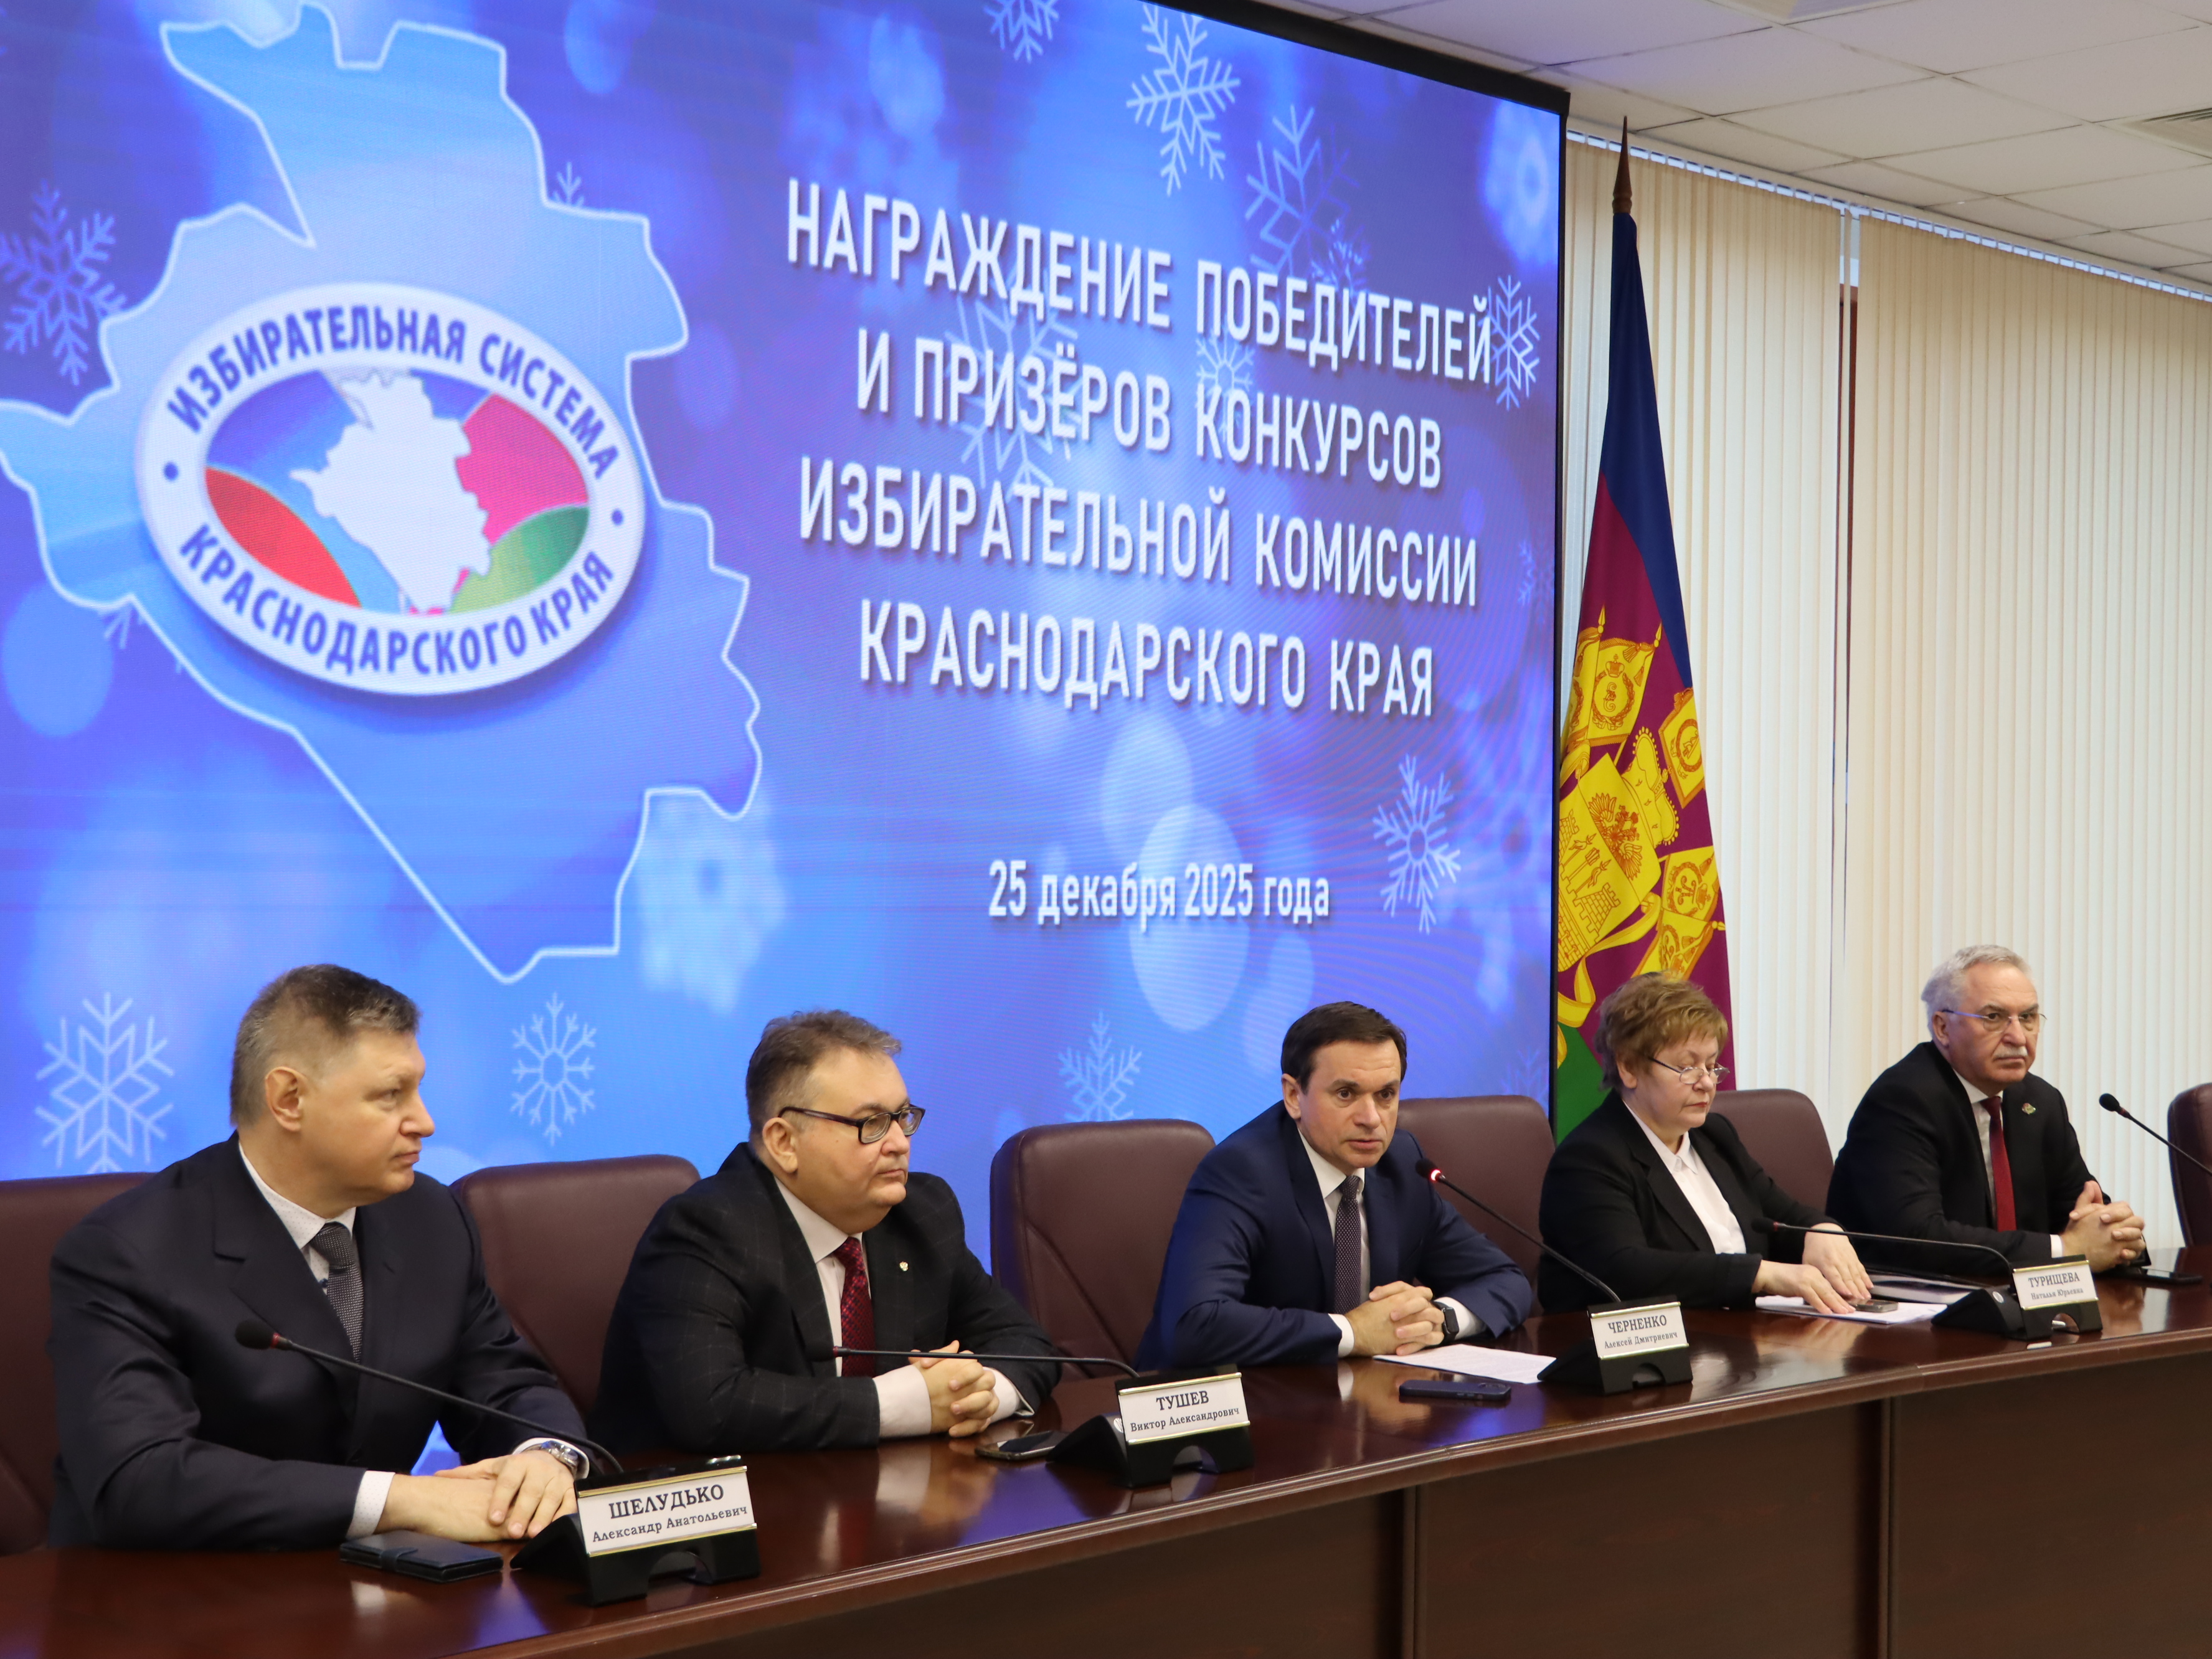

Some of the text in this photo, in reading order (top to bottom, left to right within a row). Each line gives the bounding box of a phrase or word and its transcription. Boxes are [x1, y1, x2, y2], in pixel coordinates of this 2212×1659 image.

[788, 177, 1491, 384] НАГРАЖДЕНИЕ ПОБЕДИТЕЛЕЙ
[168, 305, 619, 479] ИЗБИРАТЕЛЬНАЯ СИСТЕМА
[858, 328, 1441, 488] И ПРИЗЁРОВ КОНКУРСОВ
[800, 456, 1476, 606] ИЗБИРАТЕЛЬНОЙ КОМИССИИ
[181, 524, 613, 674] КРАСНОДАРСКОГО КРАЯ
[861, 598, 1432, 716] КРАСНОДАРСКОГО КРАЯ
[989, 860, 1329, 933] 25 декабря 2025 года
[2028, 1272, 2080, 1288] ТУРИЩЕВА
[2031, 1288, 2084, 1300] Наталья Юрьевна
[1604, 1332, 1678, 1349] Алексей Дмитриевич
[1608, 1315, 1666, 1333] ЧЕРНЕНКО
[1130, 1407, 1240, 1432] Виктор Александрович
[1156, 1391, 1209, 1411] ТУШЕВ
[608, 1484, 724, 1519] ШЕЛУДЬКО
[593, 1506, 747, 1543] Александр Анатольевич
